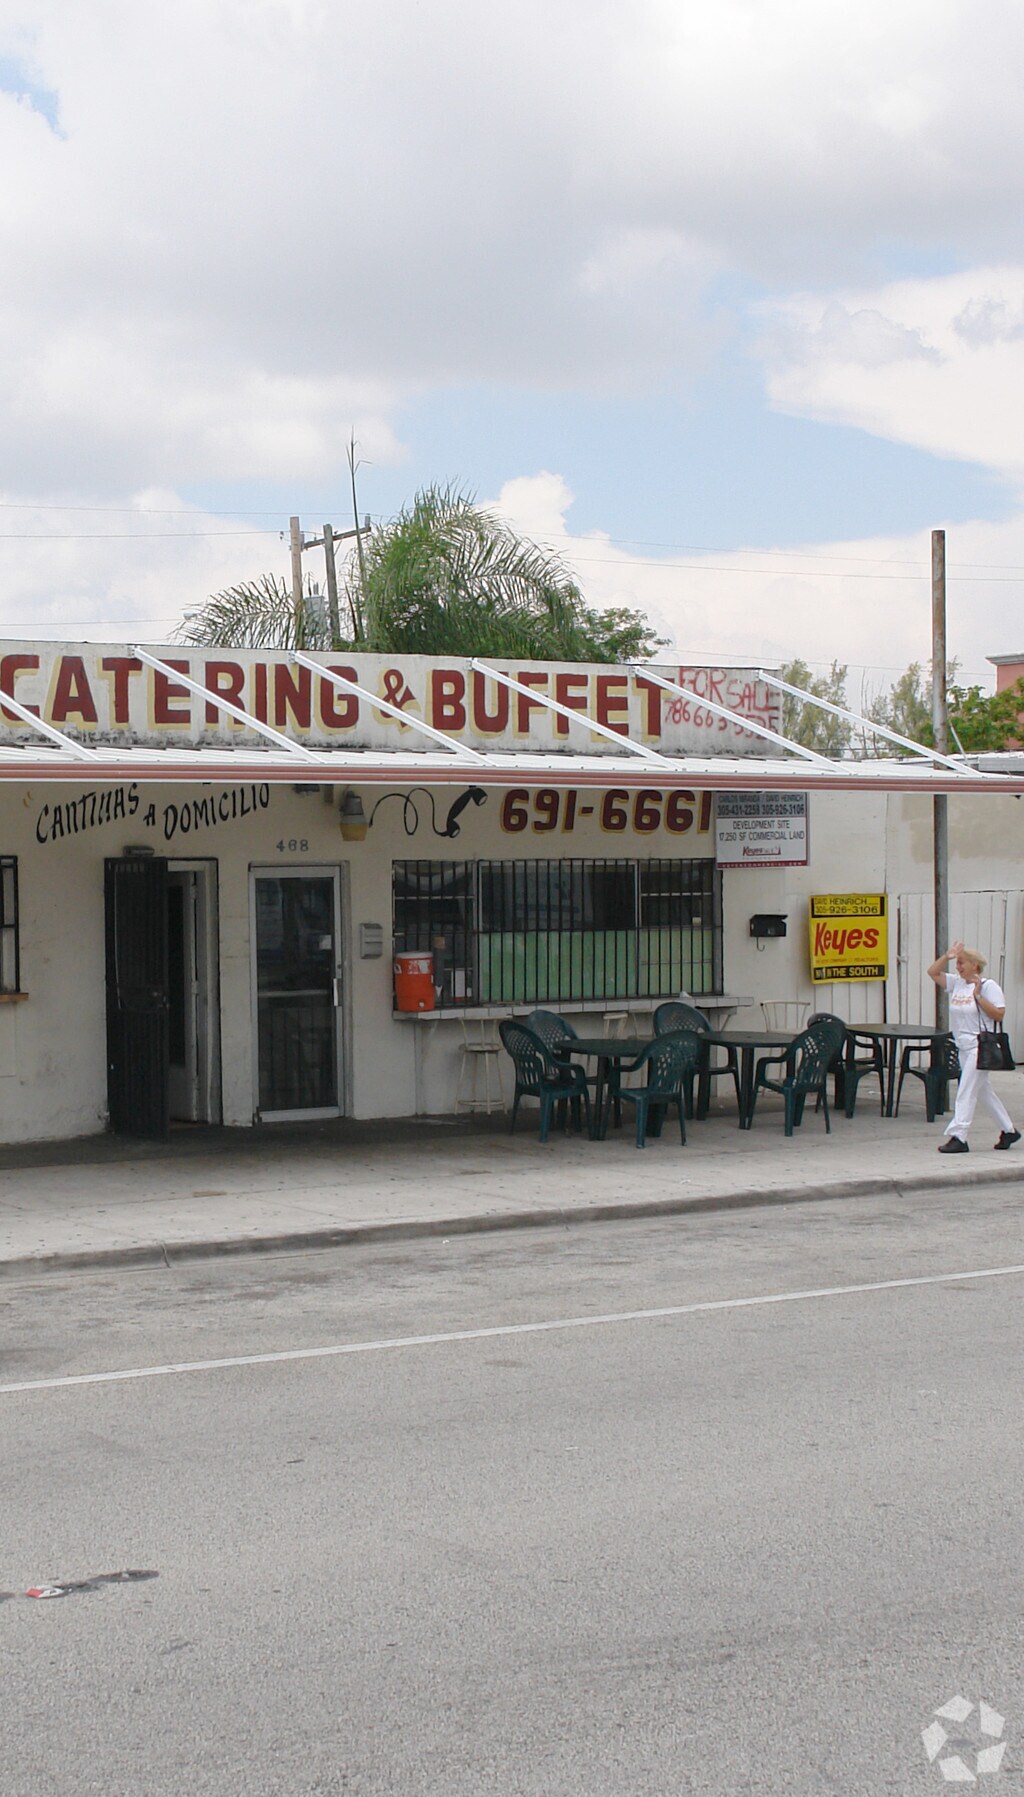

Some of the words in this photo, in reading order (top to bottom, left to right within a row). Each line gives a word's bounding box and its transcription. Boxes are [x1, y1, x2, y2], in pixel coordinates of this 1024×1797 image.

[679, 665, 726, 705] FOR
[373, 667, 423, 734] &
[426, 669, 674, 742] BUFFET
[142, 803, 157, 827] A
[163, 783, 270, 840] DOMICILIO
[500, 789, 714, 835] 691-6661
[732, 820, 775, 830] DEVELOPMENT
[777, 819, 791, 829] SITE
[739, 832, 748, 841] SF
[748, 831, 787, 841] COMMERCIAL
[789, 830, 805, 840] LAND
[829, 897, 867, 906] HEINRICH
[814, 922, 880, 957] Keyes
[832, 967, 847, 977] THE
[848, 966, 879, 976] SOUTH
